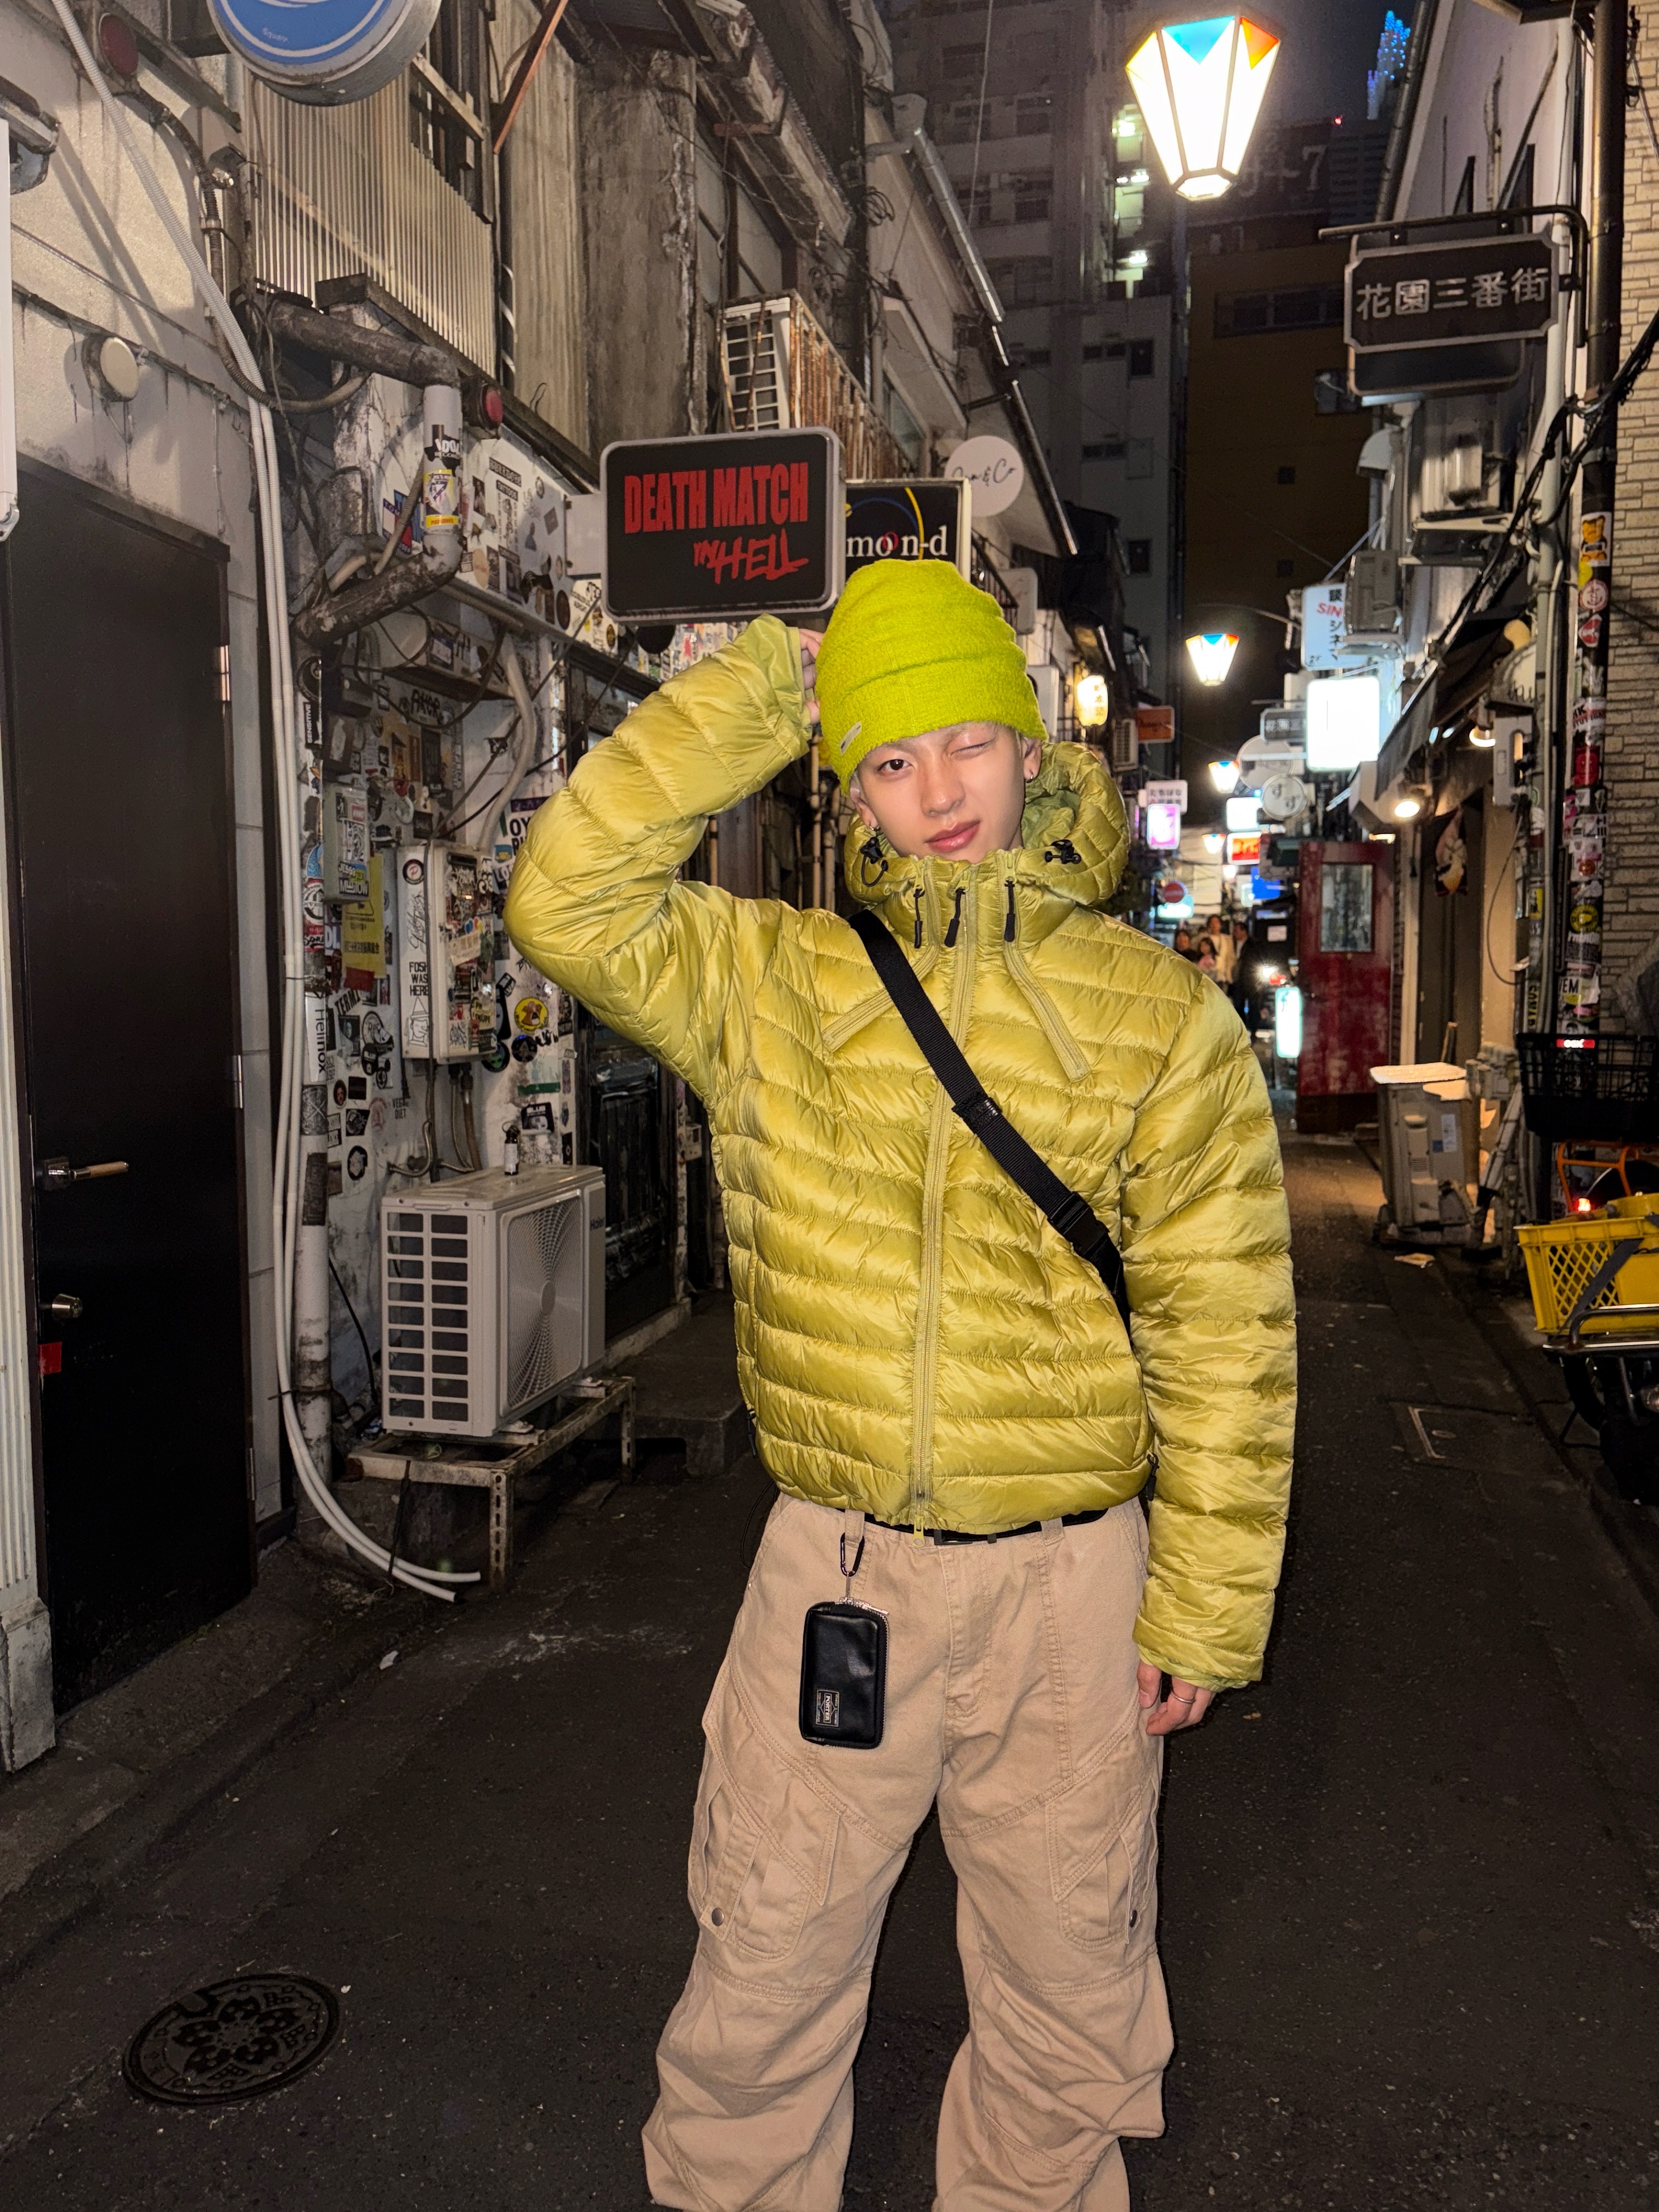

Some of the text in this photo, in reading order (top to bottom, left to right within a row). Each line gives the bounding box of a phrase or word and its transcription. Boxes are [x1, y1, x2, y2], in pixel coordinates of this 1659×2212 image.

[1356, 267, 1549, 321] 花園三番街
[624, 462, 809, 533] DEATH MATCH
[715, 528, 809, 585] HELL
[411, 974, 428, 984] WAS
[314, 1009, 326, 1074] Helinox
